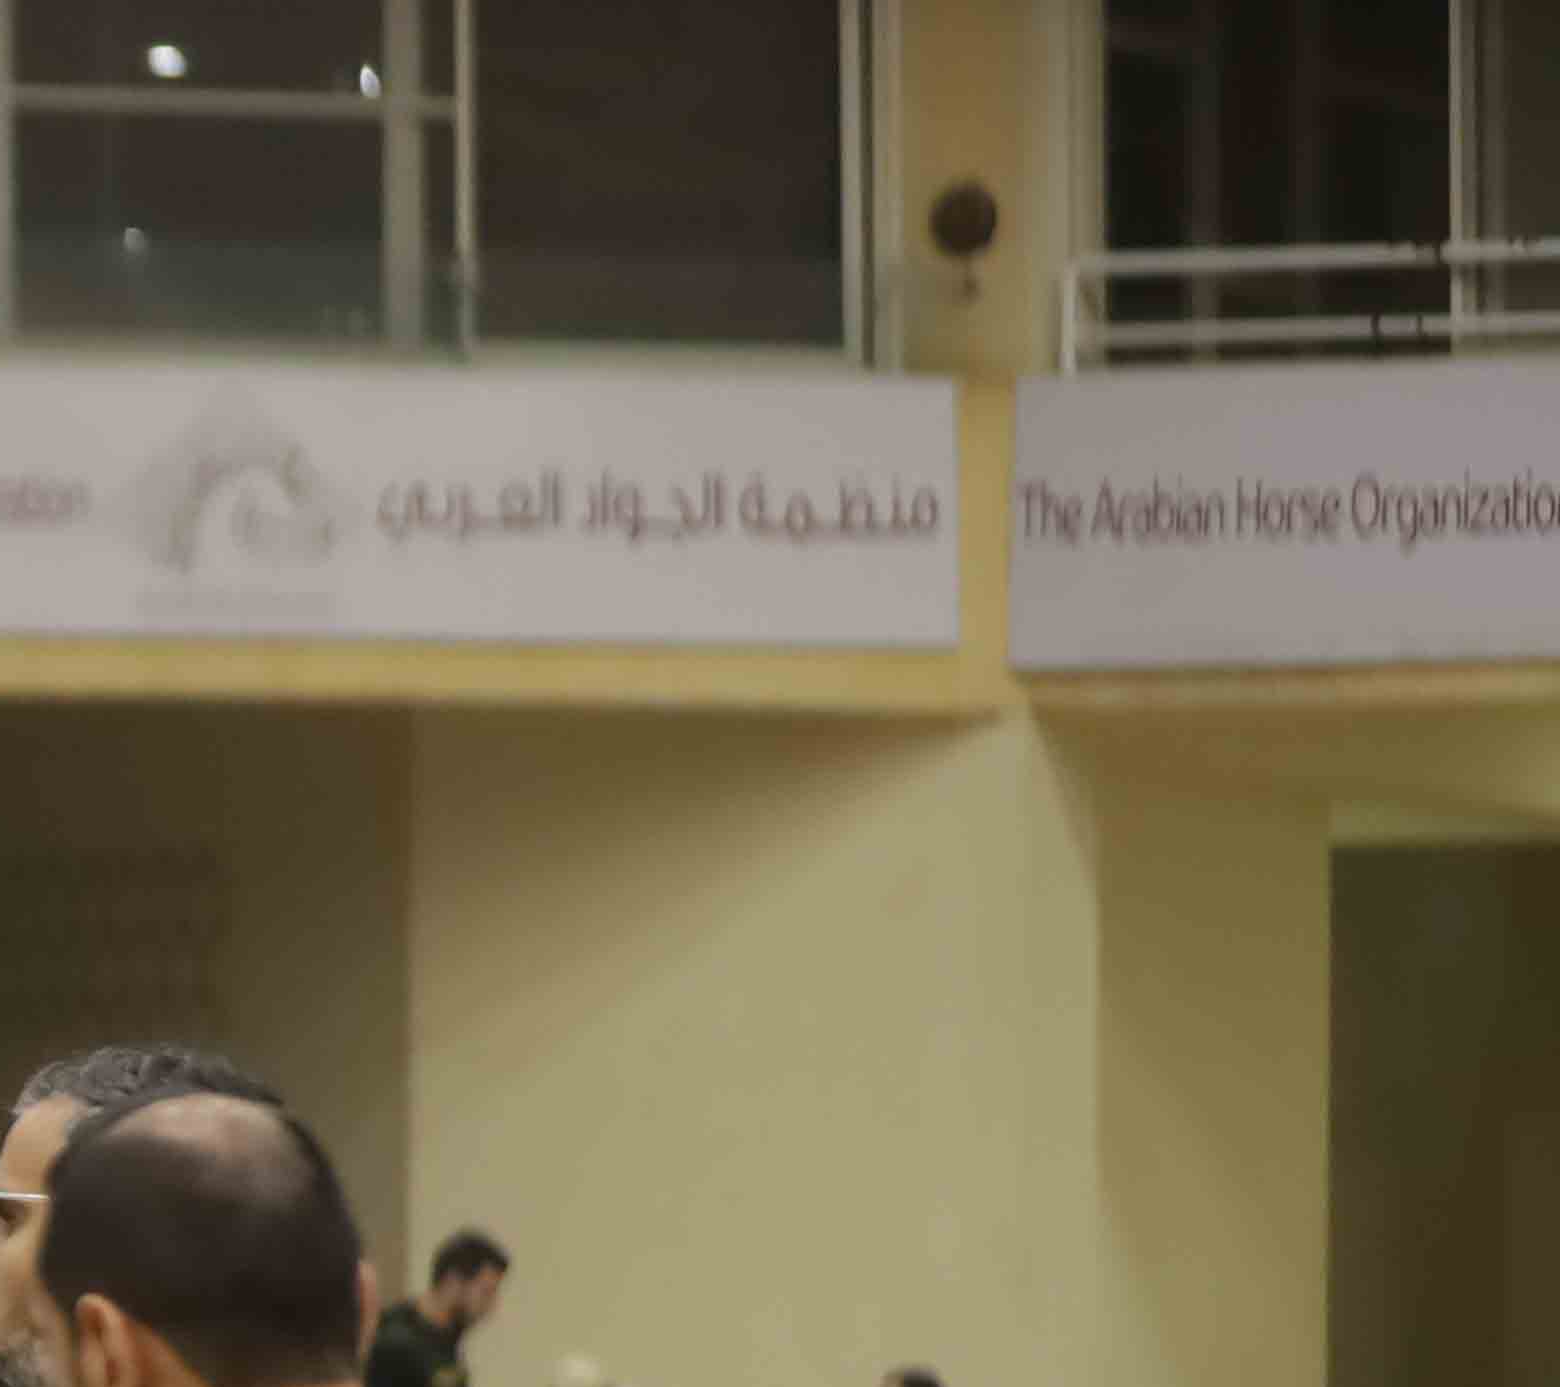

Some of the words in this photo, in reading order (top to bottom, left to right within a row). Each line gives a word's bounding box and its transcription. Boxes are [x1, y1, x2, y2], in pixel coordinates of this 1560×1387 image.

[1022, 478, 1083, 545] The
[1090, 474, 1225, 547] Arabian
[1234, 476, 1342, 545] Horse
[1351, 465, 1560, 558] Organizatio
